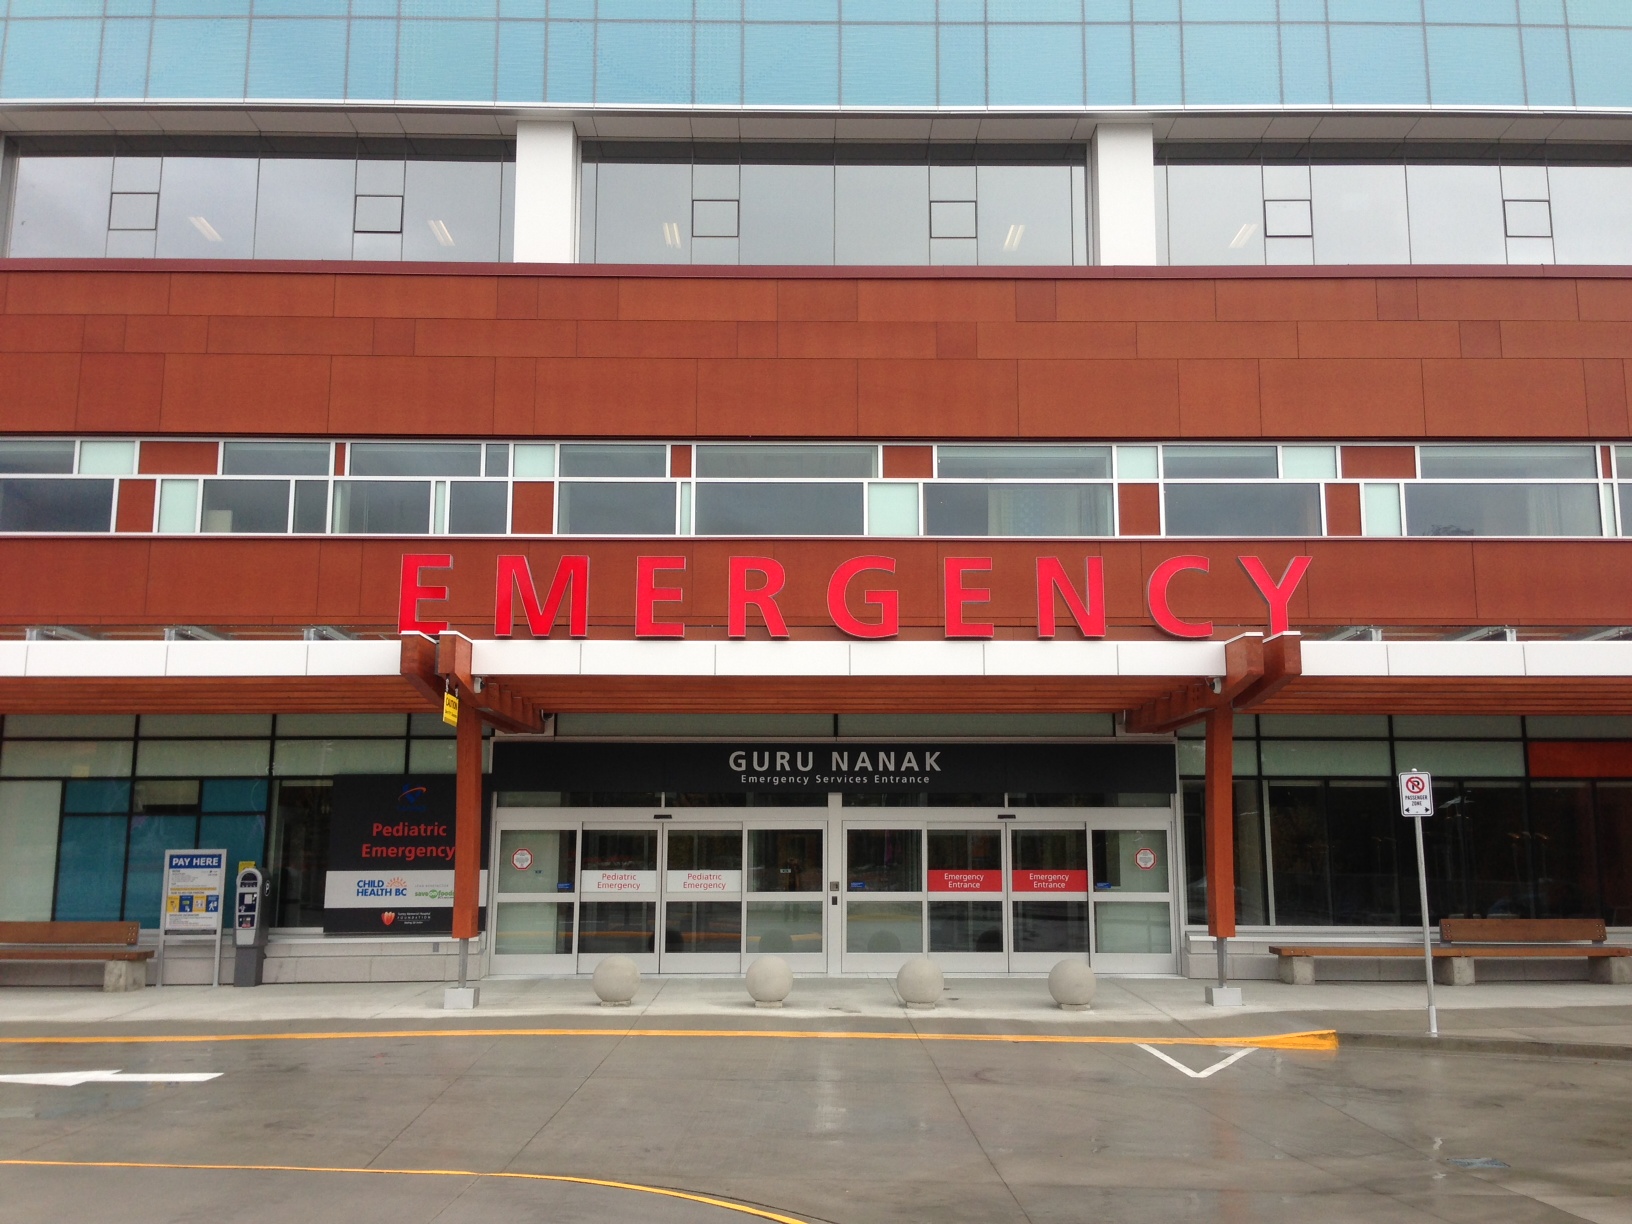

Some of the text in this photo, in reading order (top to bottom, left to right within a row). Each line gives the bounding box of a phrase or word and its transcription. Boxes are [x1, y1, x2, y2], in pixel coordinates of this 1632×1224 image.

[398, 554, 1313, 638] EMERGENCY
[729, 751, 941, 771] GURU NANAK
[741, 775, 930, 785] Emergency Services Entrance
[372, 822, 447, 836] Pediatric
[361, 844, 456, 860] Emergency
[173, 858, 218, 866] PAY HERE
[602, 873, 636, 881] Pediatric
[687, 873, 722, 881] Pediatric
[944, 873, 984, 882] Emergency
[1029, 873, 1069, 882] Emergency
[356, 879, 384, 888] CHILD
[597, 882, 641, 890] Emergency
[682, 882, 726, 890] Emergency
[948, 881, 980, 889] Entrance
[1033, 881, 1065, 889] Entrance
[356, 888, 407, 896] HEALTH BC
